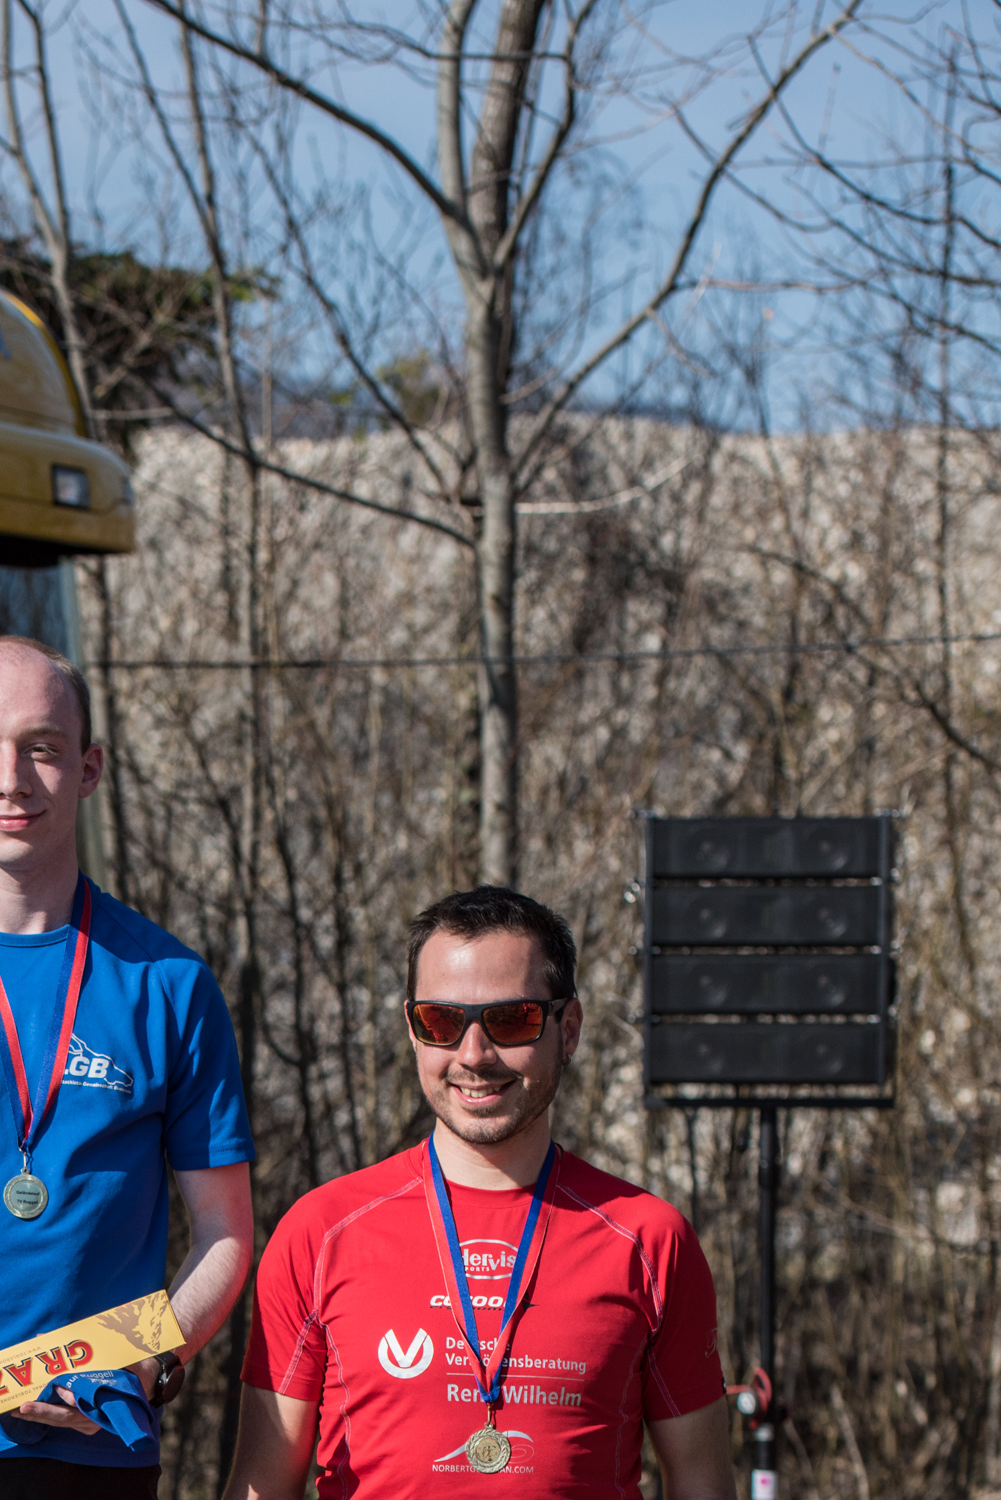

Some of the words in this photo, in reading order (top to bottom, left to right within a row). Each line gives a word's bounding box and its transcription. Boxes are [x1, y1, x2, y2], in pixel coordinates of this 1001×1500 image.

[64, 1055, 110, 1079] GB
[445, 1353, 587, 1375] Veröensberatung
[447, 1384, 485, 1402] Ren
[503, 1385, 582, 1407] Wilhelm
